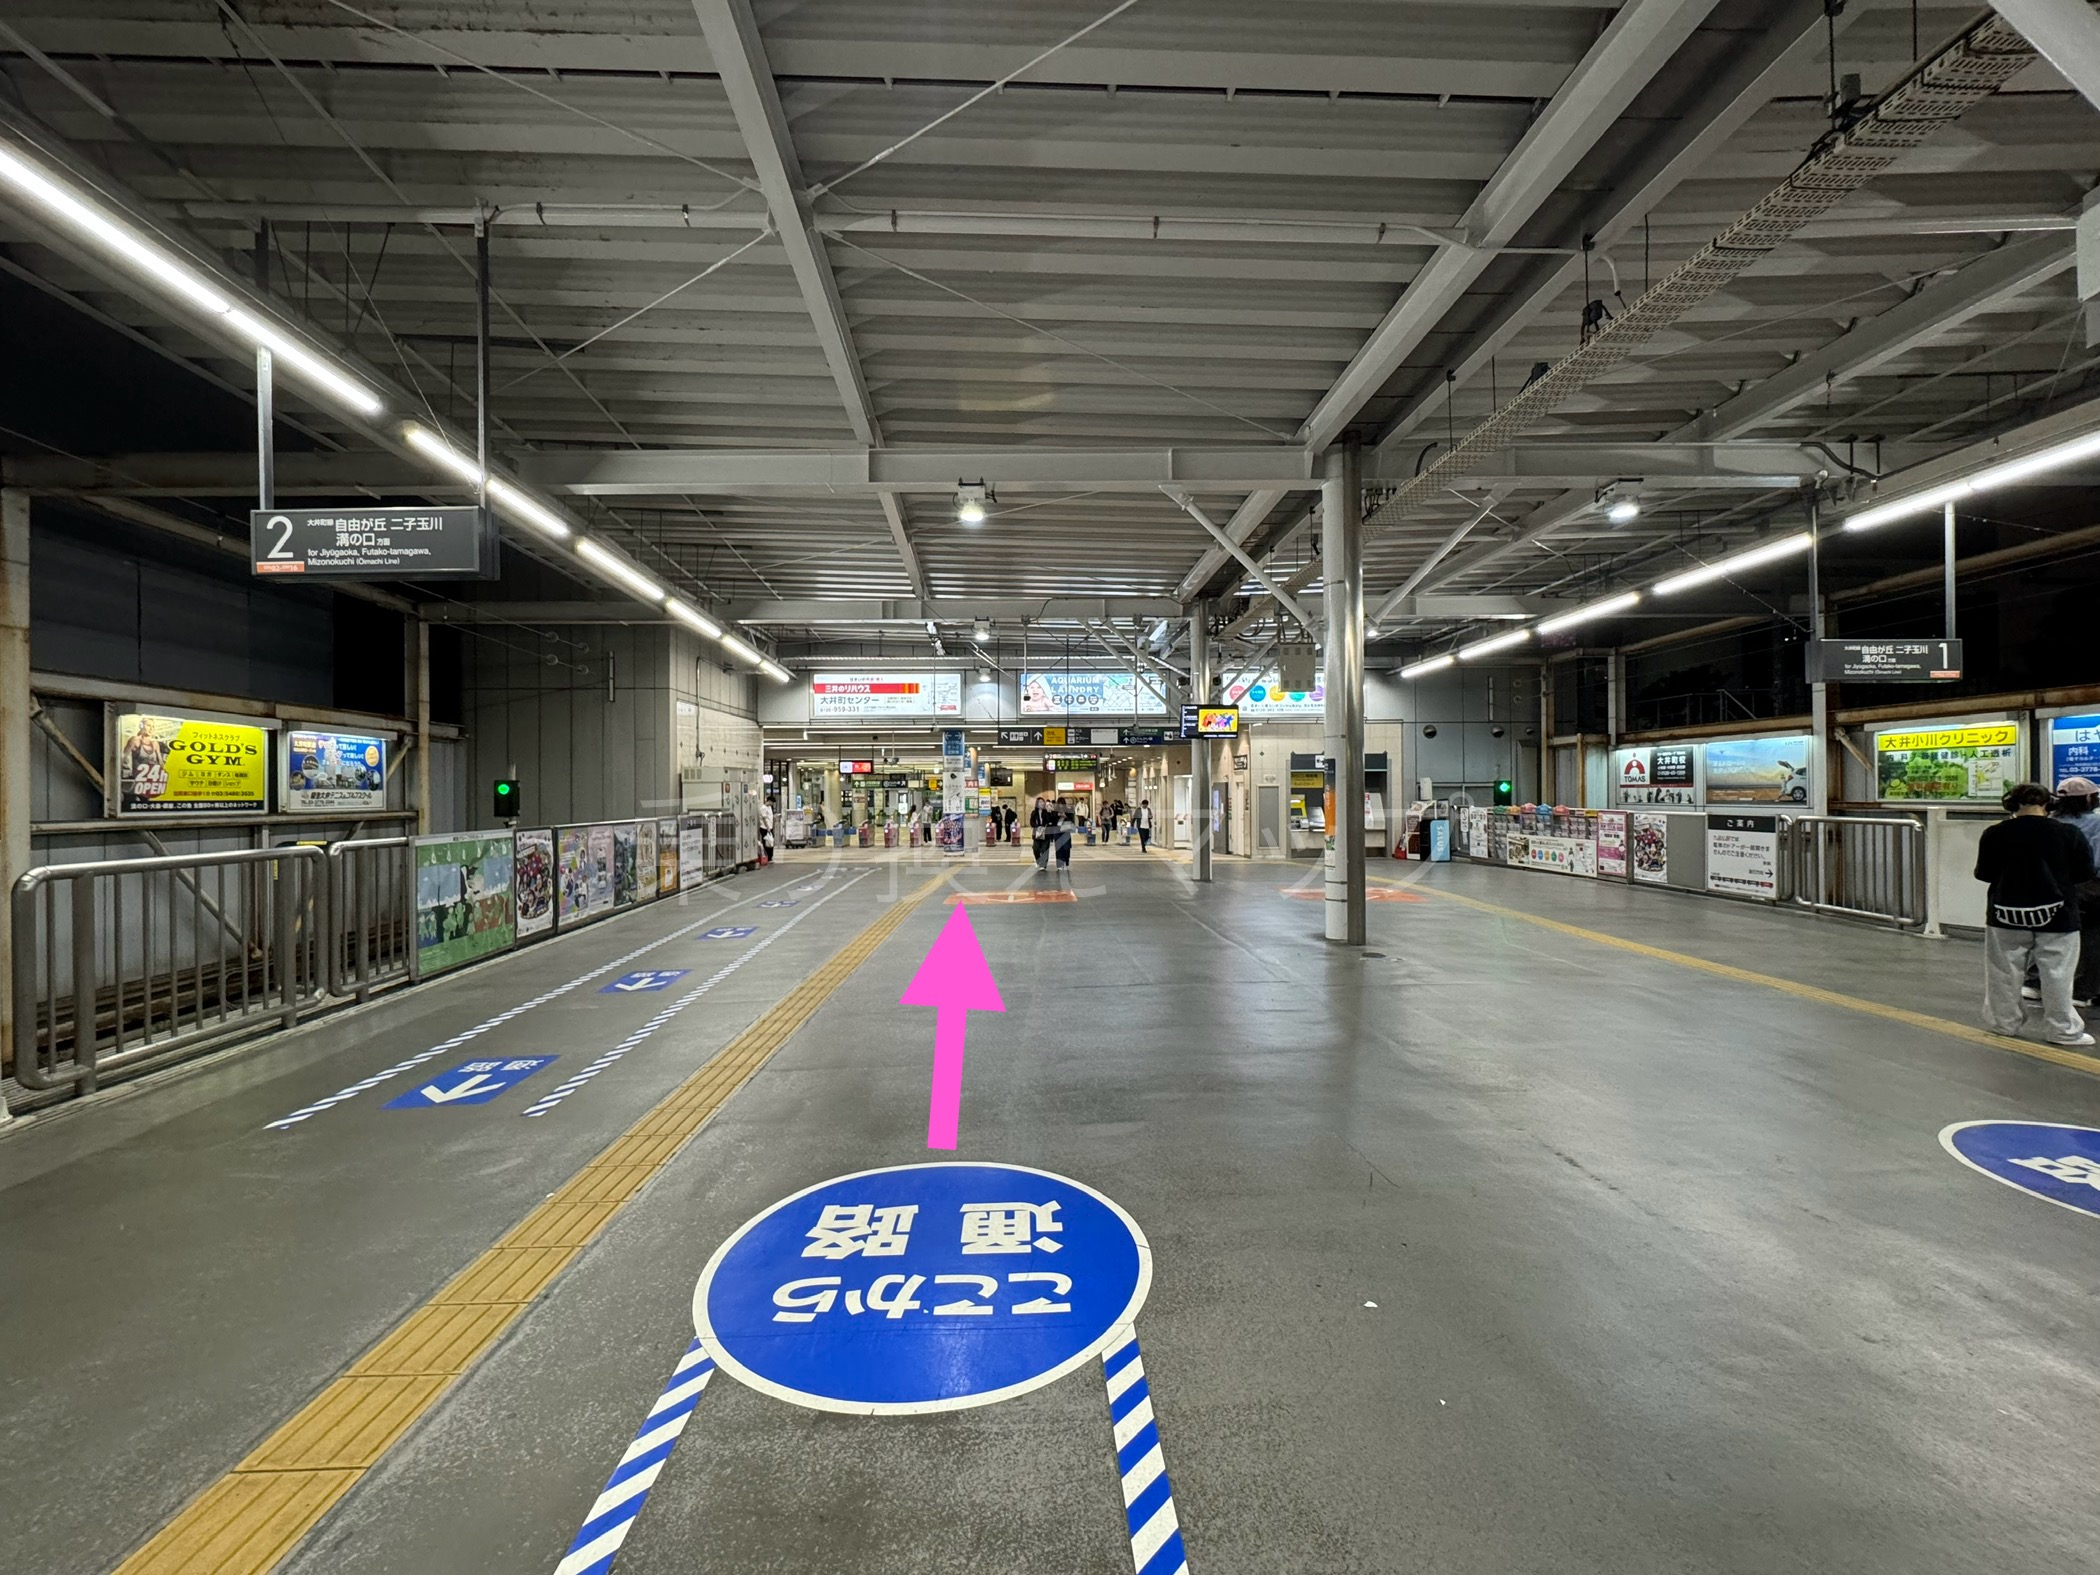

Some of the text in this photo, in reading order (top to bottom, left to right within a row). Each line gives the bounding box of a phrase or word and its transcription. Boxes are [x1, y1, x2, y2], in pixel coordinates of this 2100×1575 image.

[335, 518, 388, 532] 自由が丘
[390, 516, 443, 531] 二子玉川
[266, 515, 294, 559] 2
[336, 533, 376, 547] 溝の口
[307, 548, 318, 557] for
[361, 547, 432, 557] Futako-tamagawa,
[307, 557, 355, 566] Mizonokuchi
[384, 556, 401, 565] Line)
[1861, 644, 1894, 655] 自由が丘
[1895, 644, 1929, 655] 二子玉川
[1939, 642, 1949, 669] 1
[1050, 676, 1100, 685] AQUARIUM
[824, 684, 871, 693] 三井のリハウス
[1050, 686, 1100, 694] LAUNDRY
[820, 696, 880, 705] 大井町センター
[1884, 730, 2009, 749] 大井小川クリニック
[168, 739, 258, 756] GOLD'S
[185, 753, 243, 767] GYM
[134, 763, 169, 783] 24h
[1624, 775, 1647, 783] TOMAS
[133, 781, 167, 796] OPEN
[1726, 819, 1755, 828] ご案内
[1436, 825, 1445, 853] SALUS
[800, 1199, 1064, 1260] 通路
[771, 1271, 1073, 1323] ここから
